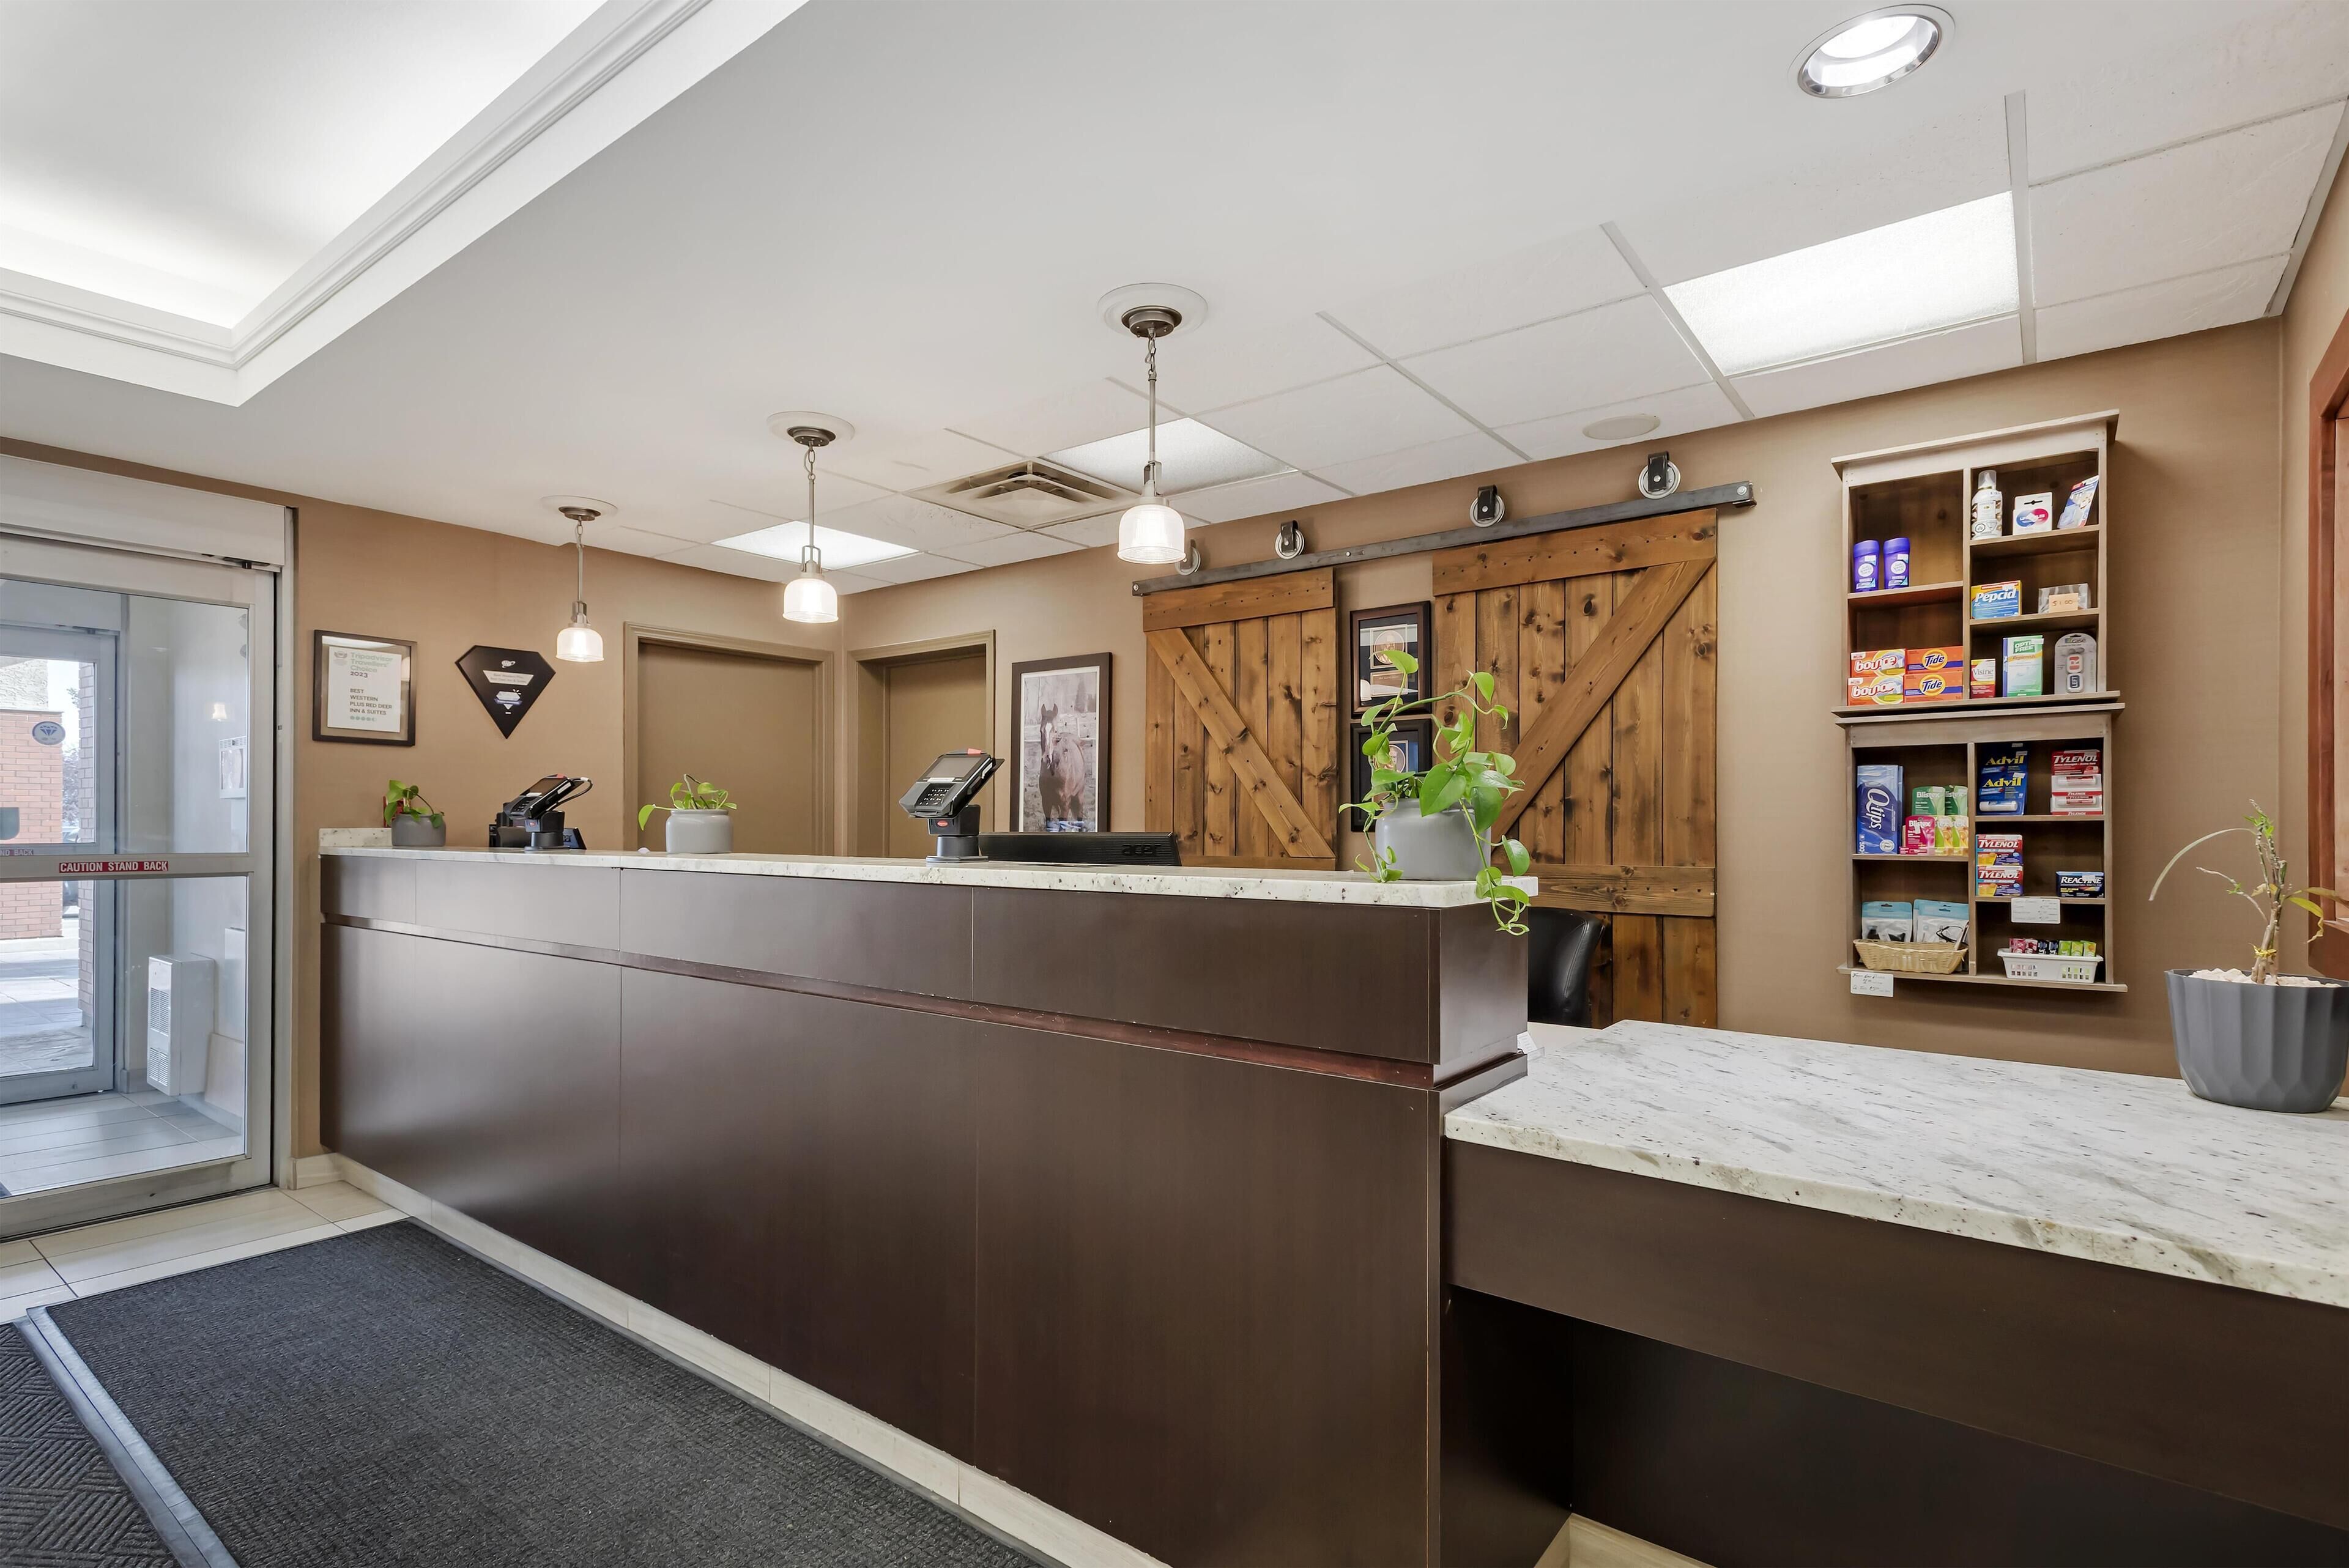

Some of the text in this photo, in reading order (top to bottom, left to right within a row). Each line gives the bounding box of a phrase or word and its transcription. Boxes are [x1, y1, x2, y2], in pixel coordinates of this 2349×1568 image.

[1975, 589, 2017, 603] Pepcid
[351, 652, 393, 662] Tripadvisor
[1924, 654, 1945, 667] Tide
[1922, 679, 1943, 692] Tide
[1985, 755, 2025, 766] Advil
[2053, 755, 2098, 764] TYLENOL
[1983, 777, 2022, 788] Advil
[1978, 839, 2019, 848] TYLENOL
[1121, 843, 1162, 856] acer
[60, 861, 168, 873] CAUTION STAND BACK
[1979, 870, 2019, 879] TYLENOL
